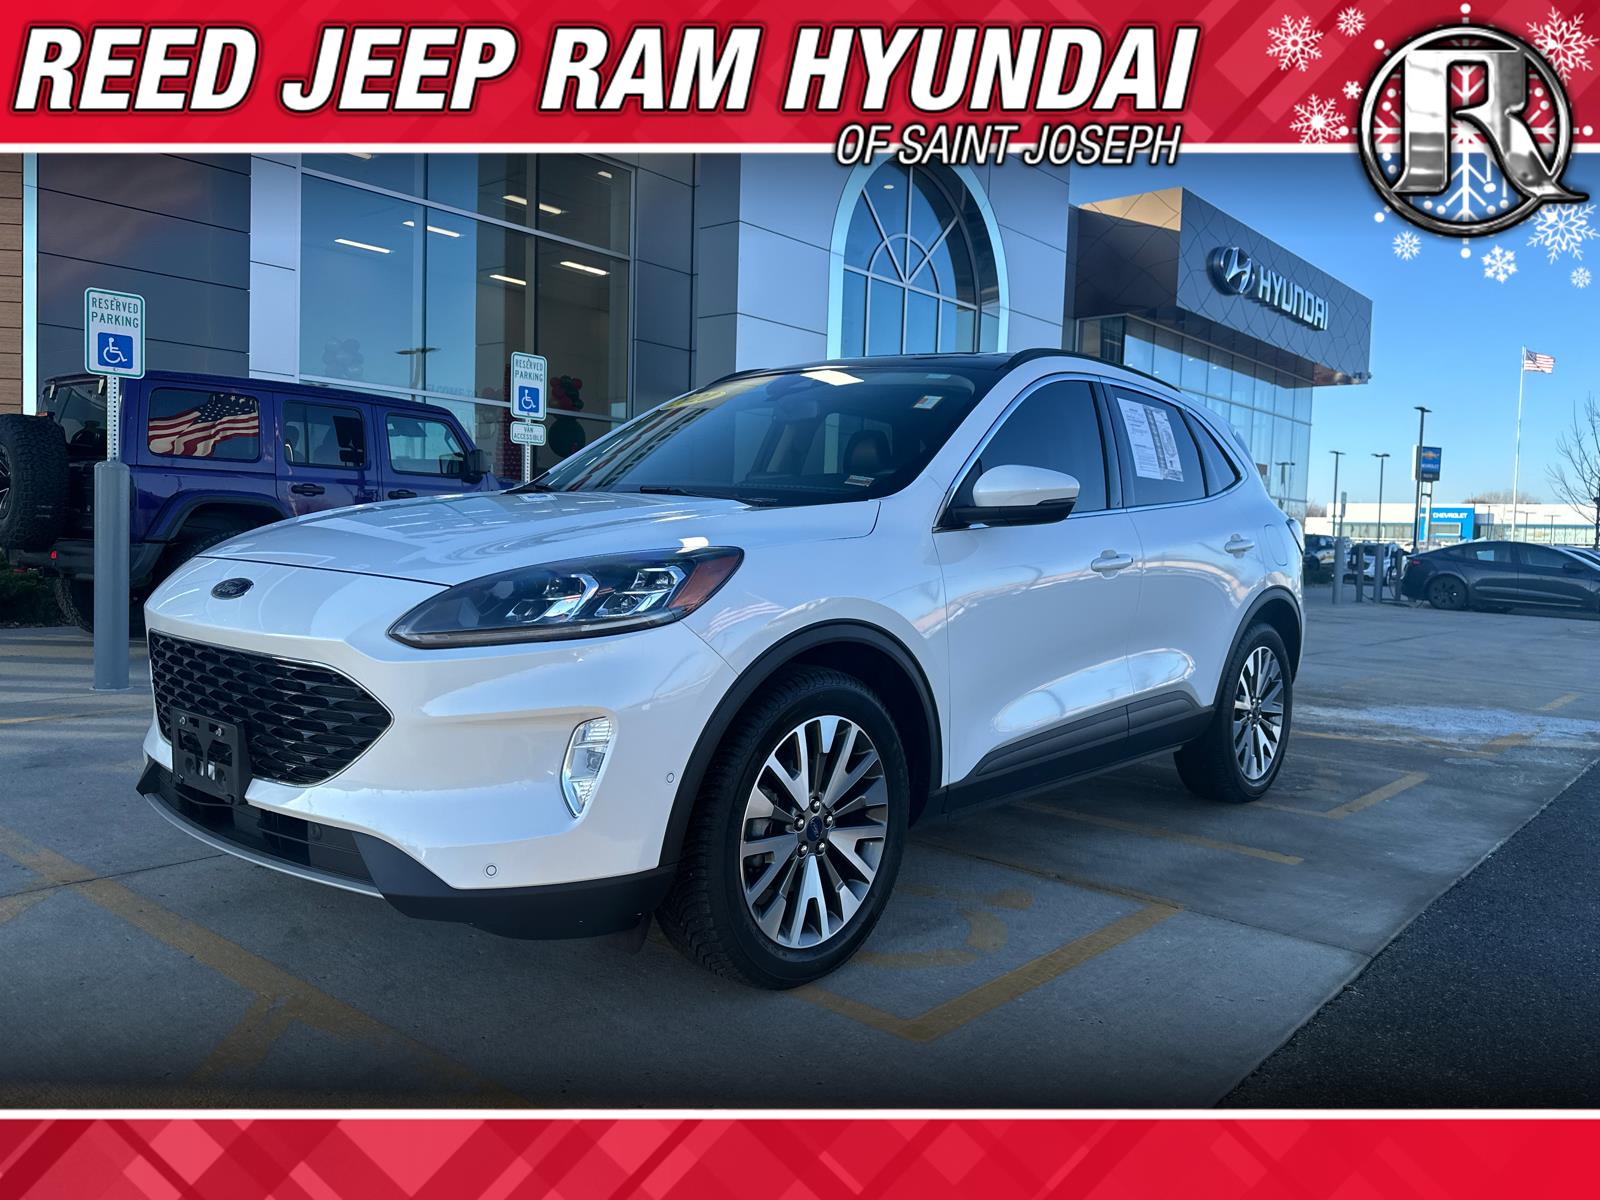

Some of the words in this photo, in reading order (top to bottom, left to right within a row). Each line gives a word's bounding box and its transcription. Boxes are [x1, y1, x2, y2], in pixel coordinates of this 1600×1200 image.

[1258, 265, 1328, 330] HYUNDAI
[91, 297, 139, 314] RESERVED
[91, 311, 139, 328] PARKING
[515, 359, 543, 371] RESERVED
[515, 370, 543, 383] PARKING
[513, 432, 543, 441] ACCESSIBLE
